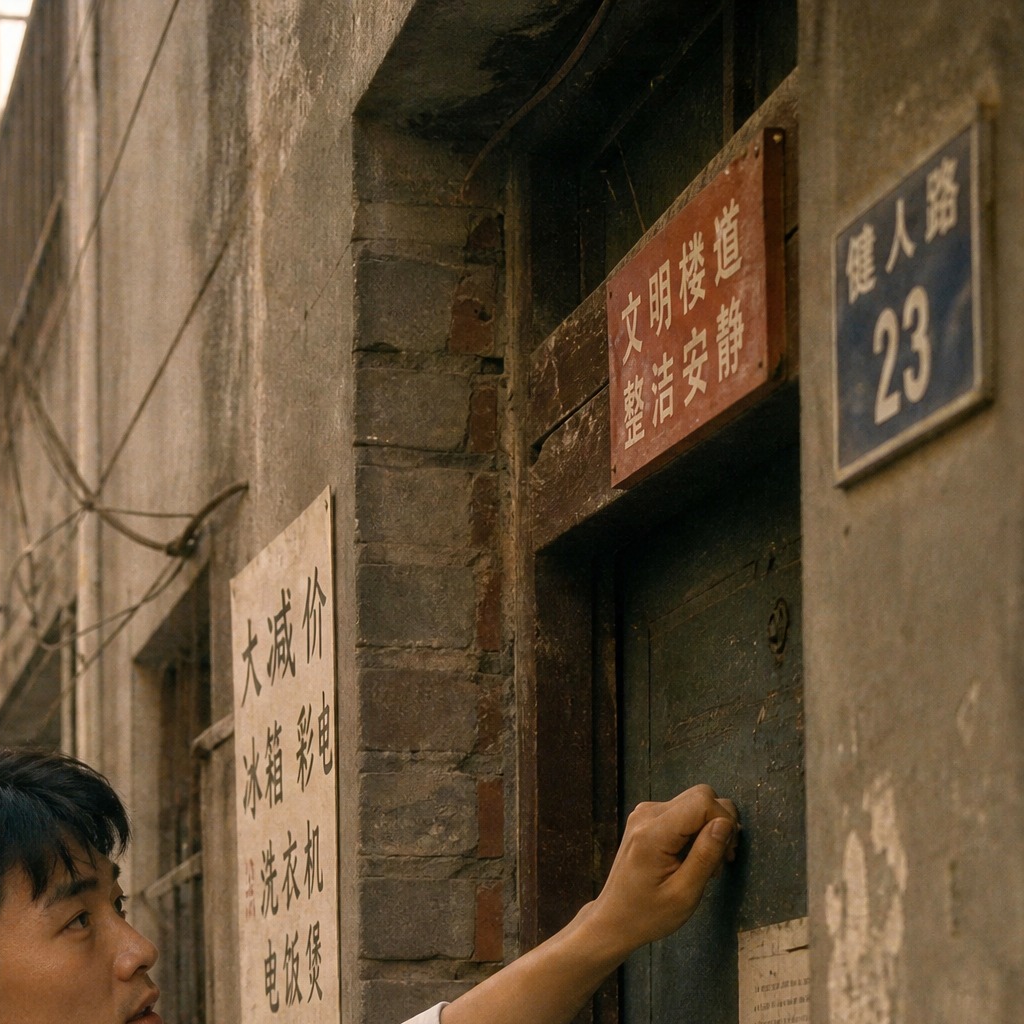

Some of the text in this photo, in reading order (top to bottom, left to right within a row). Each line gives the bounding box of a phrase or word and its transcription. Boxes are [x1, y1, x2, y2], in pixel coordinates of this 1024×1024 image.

[621, 198, 743, 366] 文明楼道
[845, 156, 960, 305] 健人路
[623, 296, 745, 450] 整洁安静
[872, 286, 931, 425] 23
[241, 566, 327, 708] 大减价
[243, 690, 333, 820] 冰箱 彩电
[260, 819, 324, 919] 洗衣机
[264, 920, 323, 1014] 电饭煲
